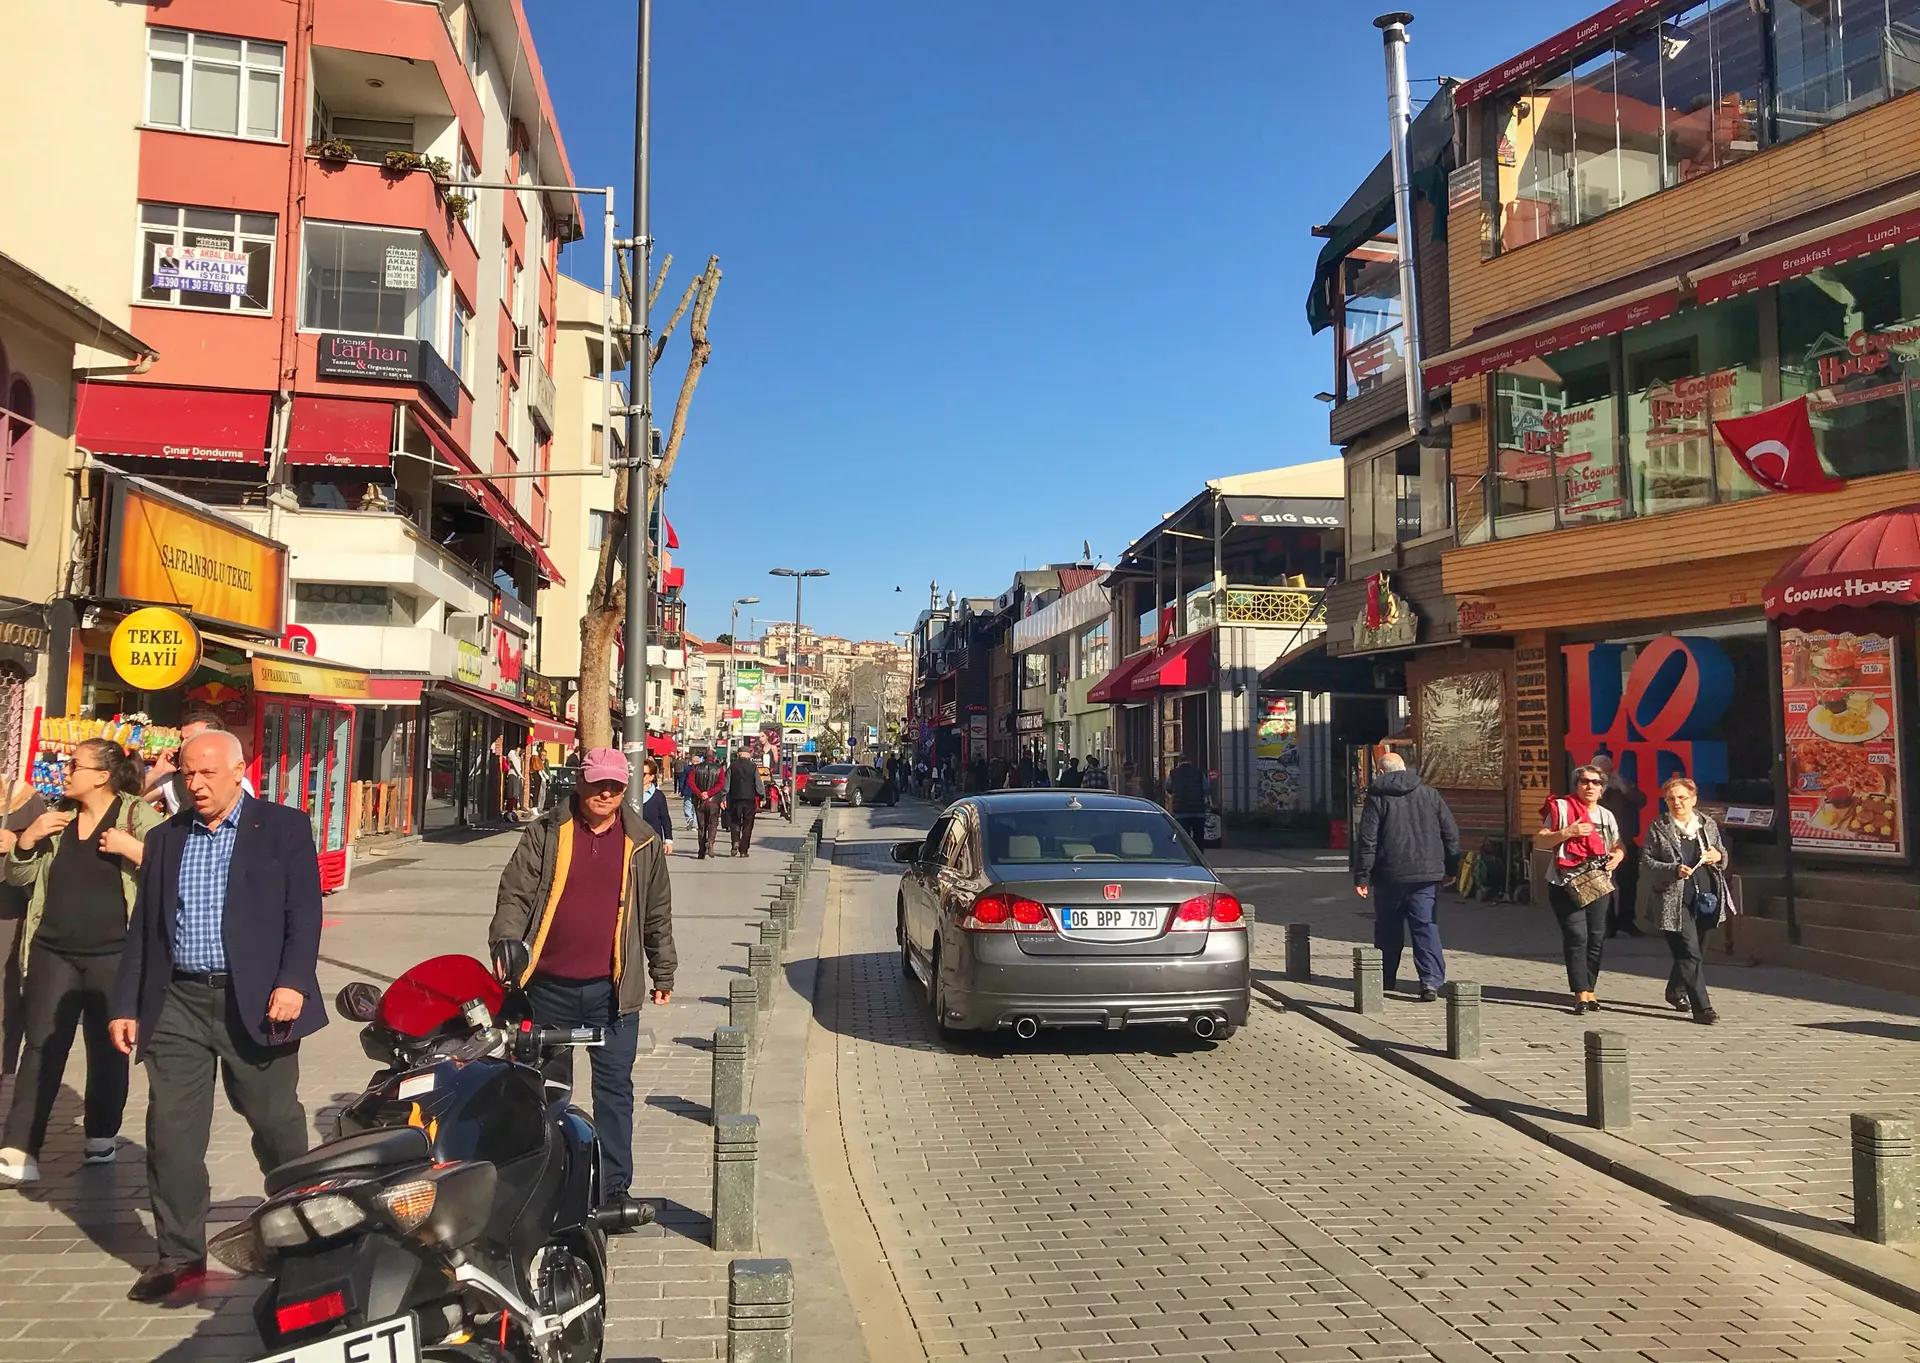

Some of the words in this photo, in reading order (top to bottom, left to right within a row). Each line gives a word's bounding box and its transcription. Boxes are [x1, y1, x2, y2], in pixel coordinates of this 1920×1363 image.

[1576, 22, 1599, 40] Lunch
[1503, 56, 1536, 79] Breakfast
[200, 250, 223, 259] AKBAL
[223, 252, 247, 261] EMLAK
[1782, 247, 1831, 271] Breakfast
[1867, 225, 1901, 243] Lunch
[387, 258, 416, 266] AKBAL
[165, 277, 179, 288] 390
[181, 279, 190, 288] 11
[191, 281, 201, 290] 30
[209, 281, 223, 292] 765
[225, 283, 234, 293] 98
[236, 284, 246, 294] 55
[331, 338, 408, 362] tarhan
[1480, 350, 1513, 366] Breakfast
[1535, 335, 1557, 349] Lunch
[1580, 320, 1606, 335] Dinner
[163, 445, 190, 456] Çınar
[192, 447, 244, 458] Dondurma
[1261, 514, 1298, 523] BIG
[1302, 515, 1339, 525] BIG
[161, 544, 226, 583] SAFRANBOLU
[227, 565, 253, 592] TEKEL
[128, 629, 182, 645] TEKEL
[1072, 911, 1088, 926] 06
[1097, 911, 1121, 926] BPP
[1130, 911, 1154, 927] 787
